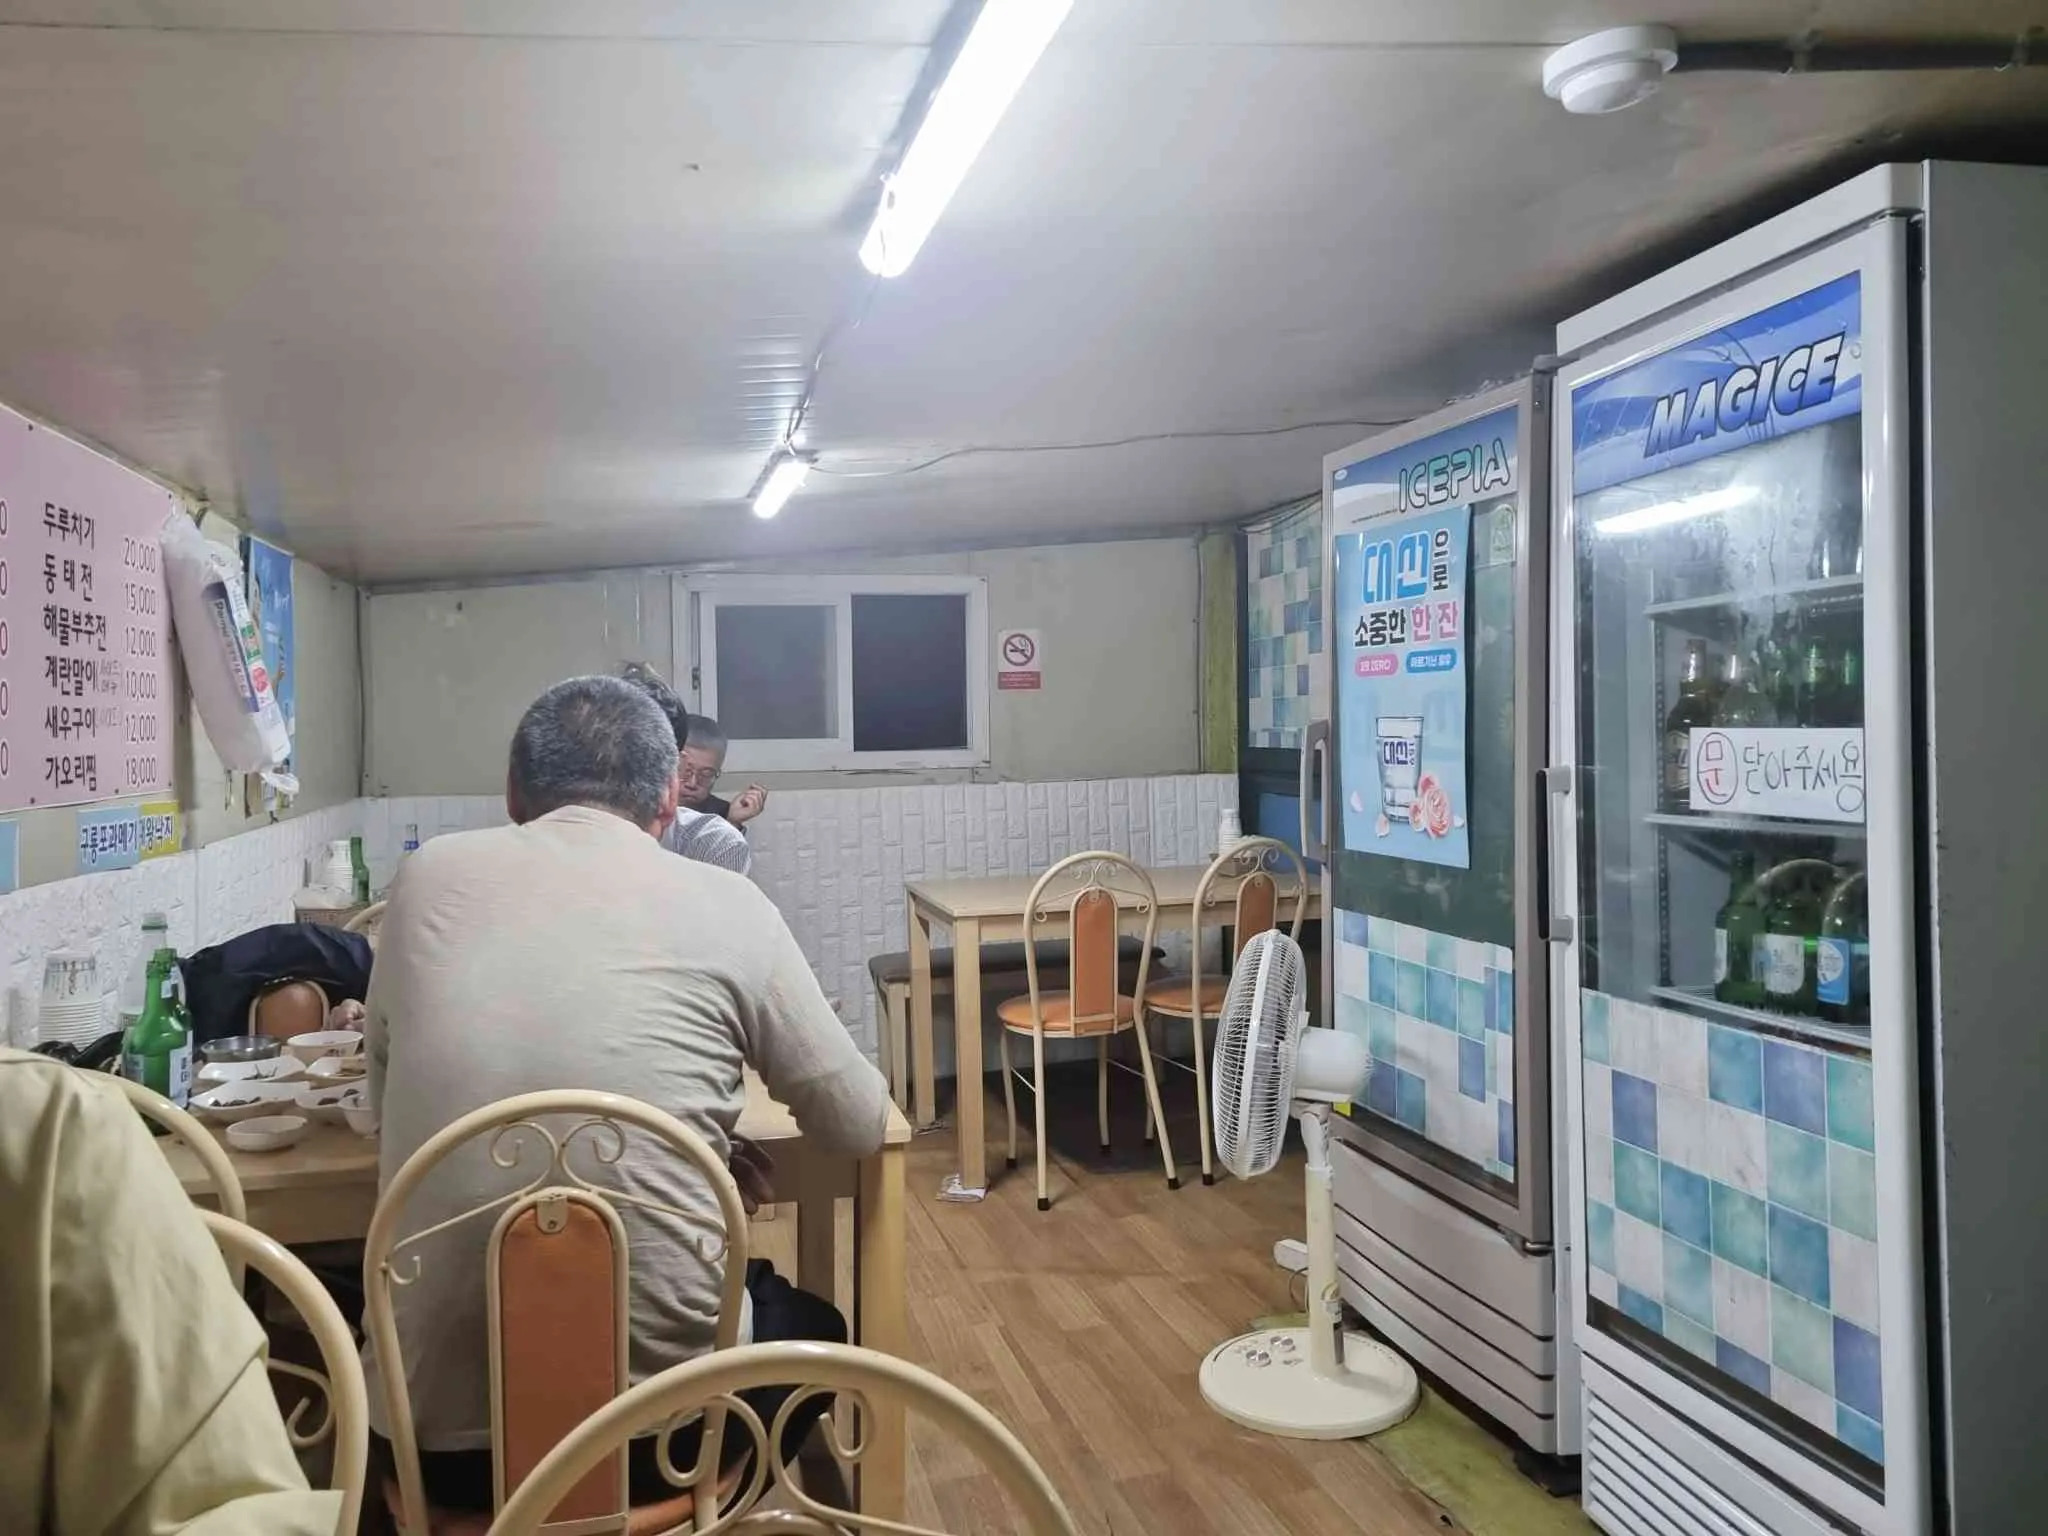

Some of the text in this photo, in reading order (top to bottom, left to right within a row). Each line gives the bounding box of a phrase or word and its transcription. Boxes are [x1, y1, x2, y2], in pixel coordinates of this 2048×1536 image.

[1644, 331, 1845, 458] MAGICE
[1399, 438, 1511, 502] ICEPIA
[44, 502, 155, 573] 두루치기 20,000
[125, 583, 155, 615] 15,000
[1355, 601, 1459, 647] 소중한 한 잔
[43, 603, 155, 657] 해물부추전 12,000
[45, 656, 95, 696] 계란말이
[126, 671, 156, 700] 10,000
[45, 705, 95, 741] 새우구이
[126, 714, 156, 744] 12,000
[45, 754, 156, 791] 가오리찜 18,000
[1699, 738, 1732, 799] 문
